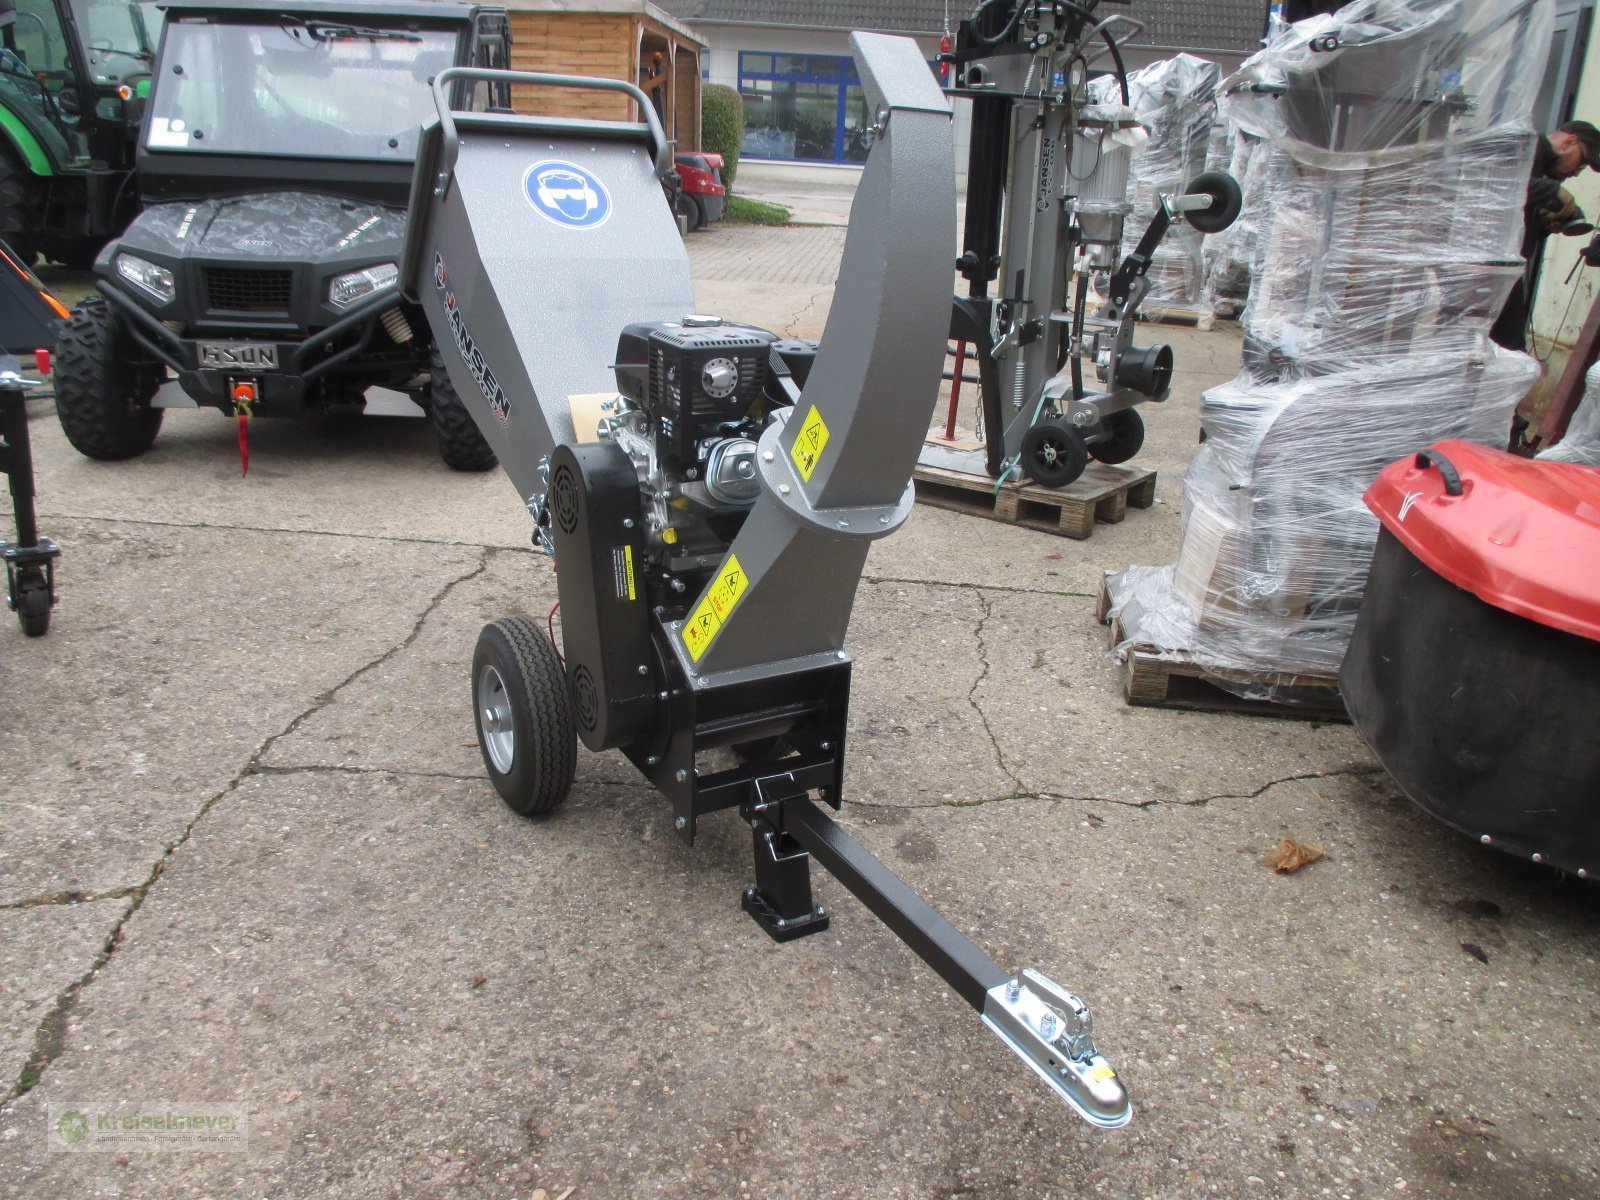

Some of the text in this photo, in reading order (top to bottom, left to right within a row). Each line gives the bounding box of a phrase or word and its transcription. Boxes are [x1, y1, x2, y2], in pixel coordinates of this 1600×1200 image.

[1041, 138, 1050, 195] JANSEN
[445, 291, 512, 421] JANSEN
[712, 596, 723, 612] STOP
